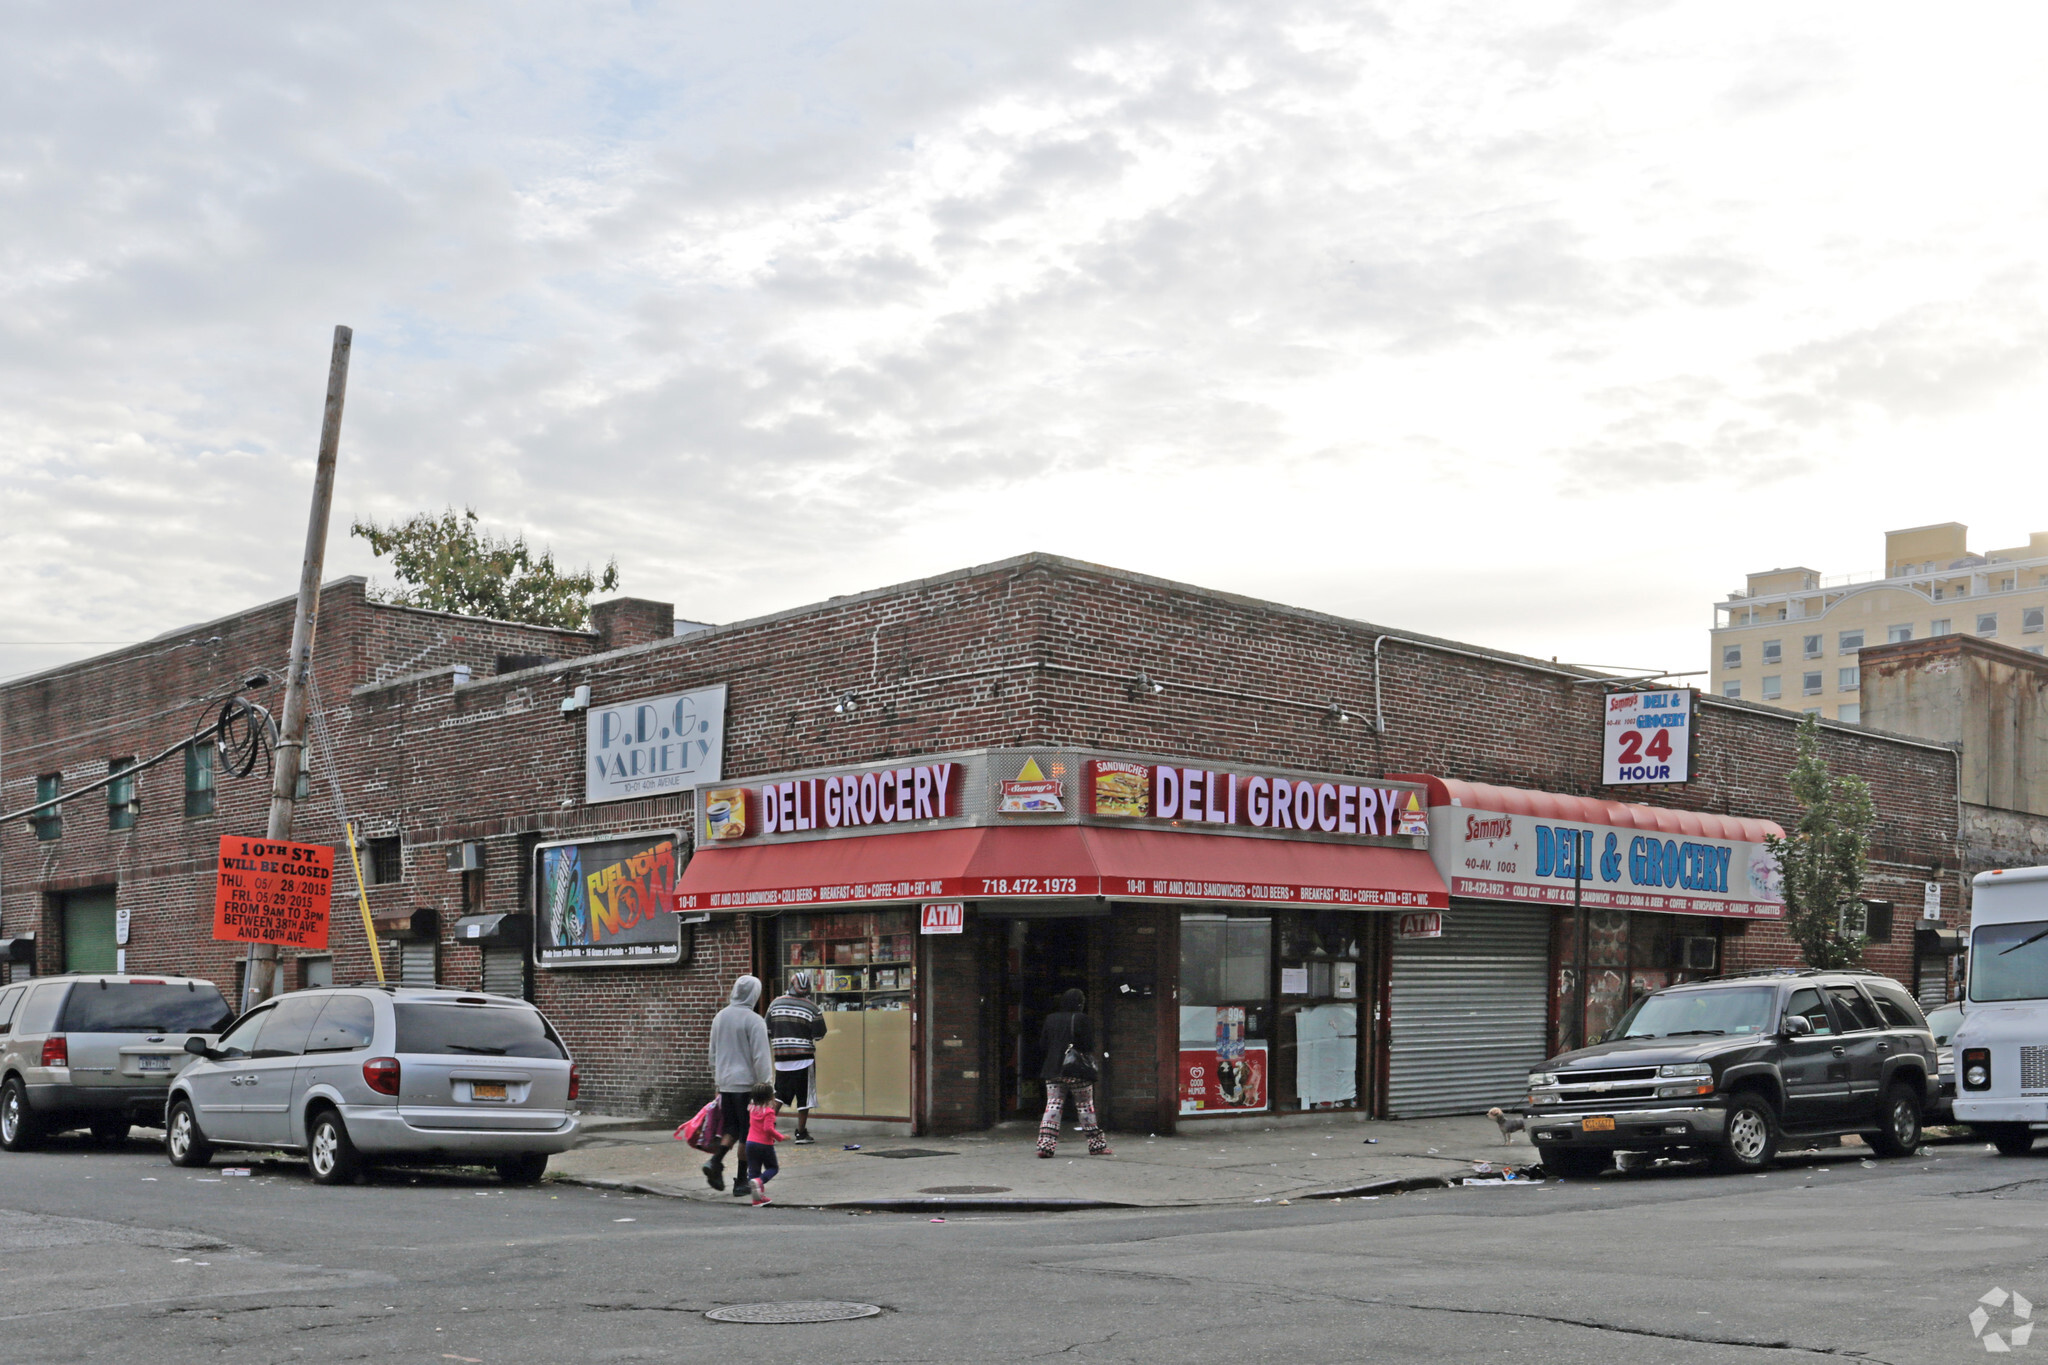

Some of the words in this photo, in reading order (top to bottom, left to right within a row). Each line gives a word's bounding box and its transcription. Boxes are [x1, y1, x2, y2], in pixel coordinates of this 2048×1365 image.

[1609, 693, 1638, 712] Sammy's
[1643, 694, 1668, 709] DELI
[1671, 693, 1680, 707] &
[600, 697, 709, 749] P.D.G.
[1636, 712, 1686, 729] GROCERY
[1618, 729, 1673, 764] 24
[594, 737, 715, 781] VARIETY
[1096, 761, 1149, 779] SANDWICHES
[1619, 765, 1670, 781] HOUR
[624, 781, 641, 793] 10-01
[657, 776, 681, 788] AVENUE
[1011, 784, 1053, 794] Sammy's
[762, 777, 818, 834] DELI
[823, 762, 952, 829] GROCERY
[1156, 765, 1236, 824] DELI
[1247, 775, 1399, 836] GROCERY
[1465, 813, 1513, 842] Sammy's
[241, 843, 288, 856] 10TH
[291, 847, 320, 863] ST.
[1535, 824, 1594, 881] DELI
[1600, 832, 1622, 883] &
[1629, 835, 1732, 893] GROCERY
[222, 857, 257, 871] WILL
[261, 861, 279, 873] BE
[281, 863, 329, 879] CLOSED
[587, 862, 626, 894] FUEL
[624, 841, 673, 880] YOUR
[1464, 857, 1492, 871] 40-AV.
[1496, 861, 1517, 874] 1003
[220, 873, 247, 888] THU.
[982, 878, 1077, 893] 718.472.1973
[255, 891, 313, 908] 05/29/2015
[587, 863, 676, 942] NOW
[678, 895, 697, 908] 10-01
[710, 894, 720, 906] HOT
[720, 893, 731, 905] AND
[732, 892, 745, 905] COLD
[745, 890, 777, 904] SANDWICHES
[782, 889, 795, 902] COLD
[796, 888, 813, 901] BEERS
[820, 886, 850, 900] BREAKFAST
[854, 885, 867, 898] DELI
[871, 883, 893, 897] COFFEE
[897, 882, 909, 896] ATM
[914, 881, 926, 895] EBT
[930, 881, 943, 895] WIC
[1127, 879, 1146, 894] 10-01
[1153, 880, 1168, 894] HOT
[1168, 881, 1183, 895] AND
[1184, 882, 1202, 896] COLD
[1203, 883, 1246, 898] SANDWICHES
[1252, 885, 1268, 898] COLD
[1270, 886, 1289, 899] BEERS
[1300, 887, 1334, 901] BREAKFAST
[1339, 889, 1353, 902] DELI
[1358, 890, 1379, 903] COFFEE
[1384, 891, 1397, 904] ATM
[1401, 892, 1412, 905] EBT
[1417, 893, 1429, 906] WIC
[1460, 880, 1505, 895] 718-472-1973
[1512, 885, 1528, 897] COLD
[1529, 886, 1541, 898] CUT
[1547, 888, 1560, 900] HOT
[1560, 889, 1565, 901] &
[1581, 891, 1611, 904] SANDWICH
[1615, 893, 1629, 905] COLD
[1630, 894, 1644, 906] SODA
[1645, 896, 1649, 907] &
[1650, 897, 1664, 908] BEER
[1669, 898, 1687, 909] COFFEE
[1692, 900, 1724, 912] NEWSPAPERS
[1729, 902, 1749, 914] CANDIES
[1754, 904, 1781, 915] CIGARETTES
[224, 901, 260, 915] FROM
[262, 904, 285, 917] 9AM
[287, 907, 301, 919] TO
[303, 909, 324, 922] 3PM
[927, 905, 960, 926] ATM
[223, 913, 273, 929] BETWEEN
[275, 917, 297, 930] 38TH
[298, 920, 319, 933] AVE.
[1404, 912, 1438, 933] ATM
[237, 926, 260, 939] AND
[262, 928, 285, 941] 40TH
[286, 931, 307, 943] AVE.
[1187, 1086, 1206, 1095] HUMOR
[1189, 1079, 1204, 1087] GOOD
